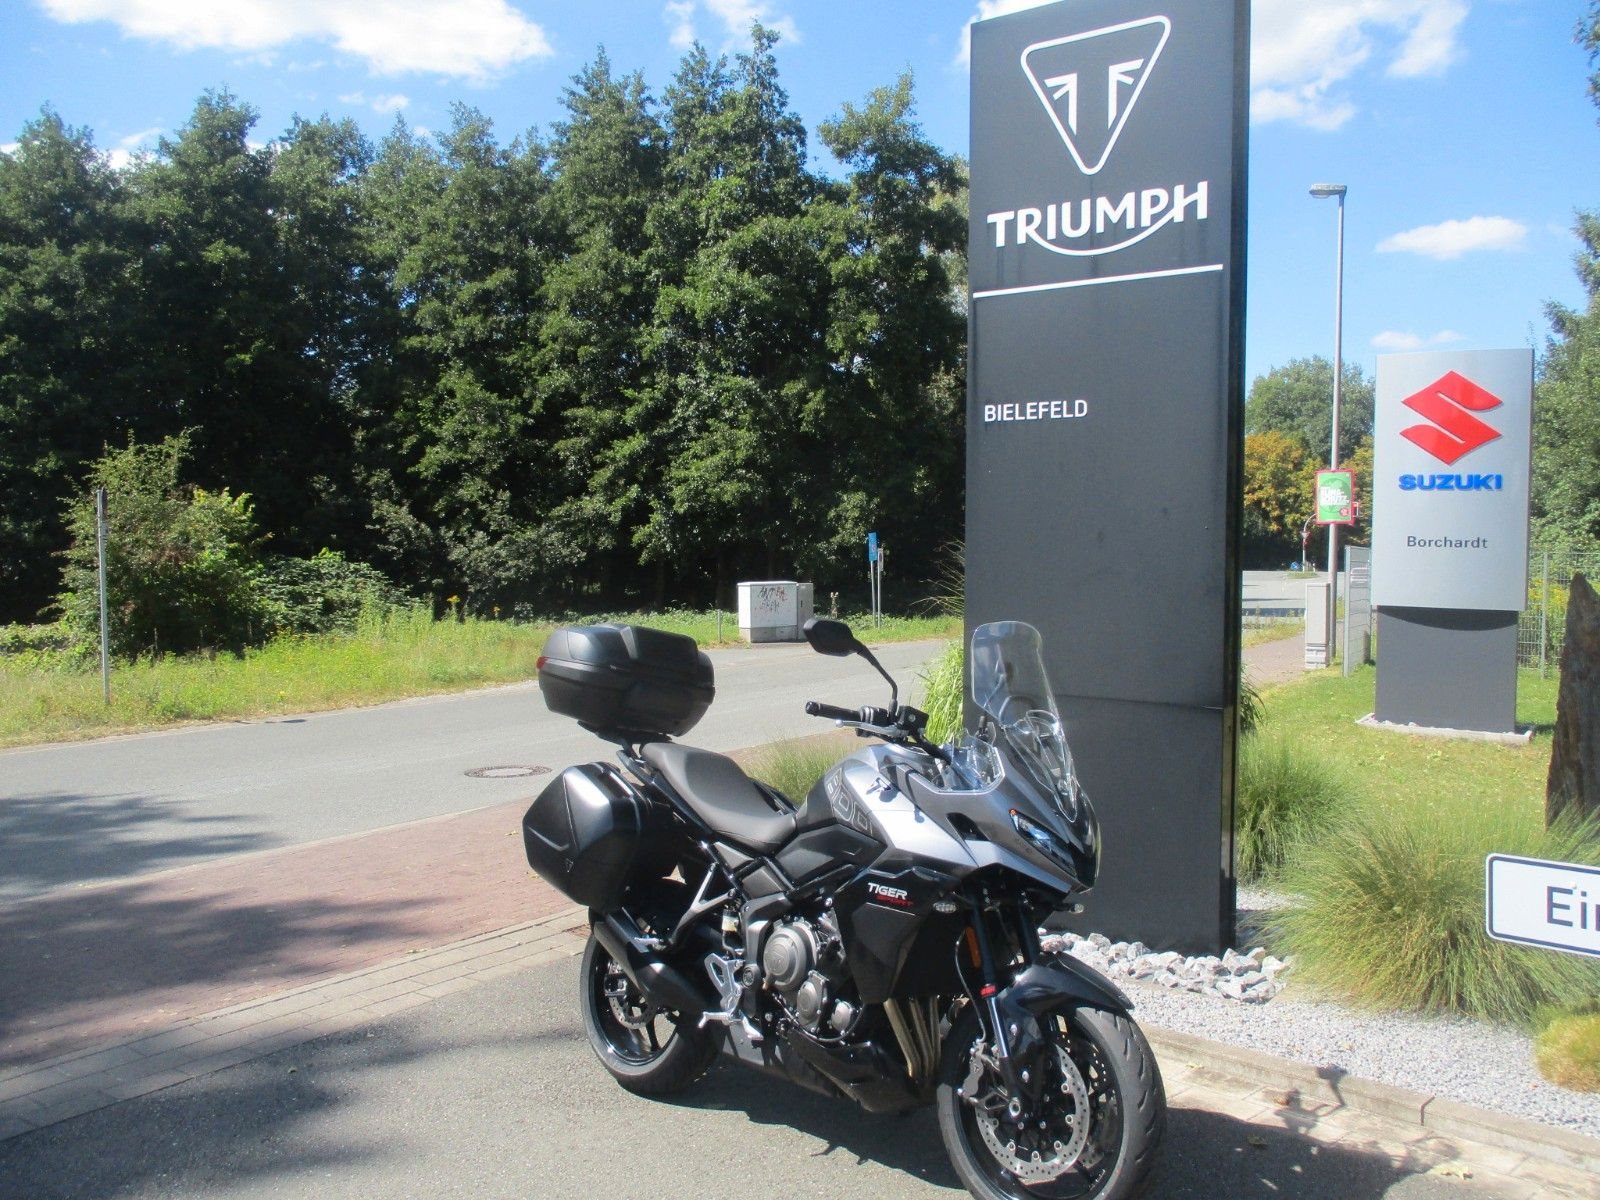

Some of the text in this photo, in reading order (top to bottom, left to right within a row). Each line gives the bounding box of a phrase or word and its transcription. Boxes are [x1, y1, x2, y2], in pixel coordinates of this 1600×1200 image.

[987, 181, 1208, 256] TRIUMPH
[984, 400, 1088, 422] BIELEFELD
[1398, 474, 1503, 491] SUZUKI
[1407, 535, 1488, 549] Borchardt
[867, 882, 908, 900] TIGER
[1547, 885, 1600, 931] Ei
